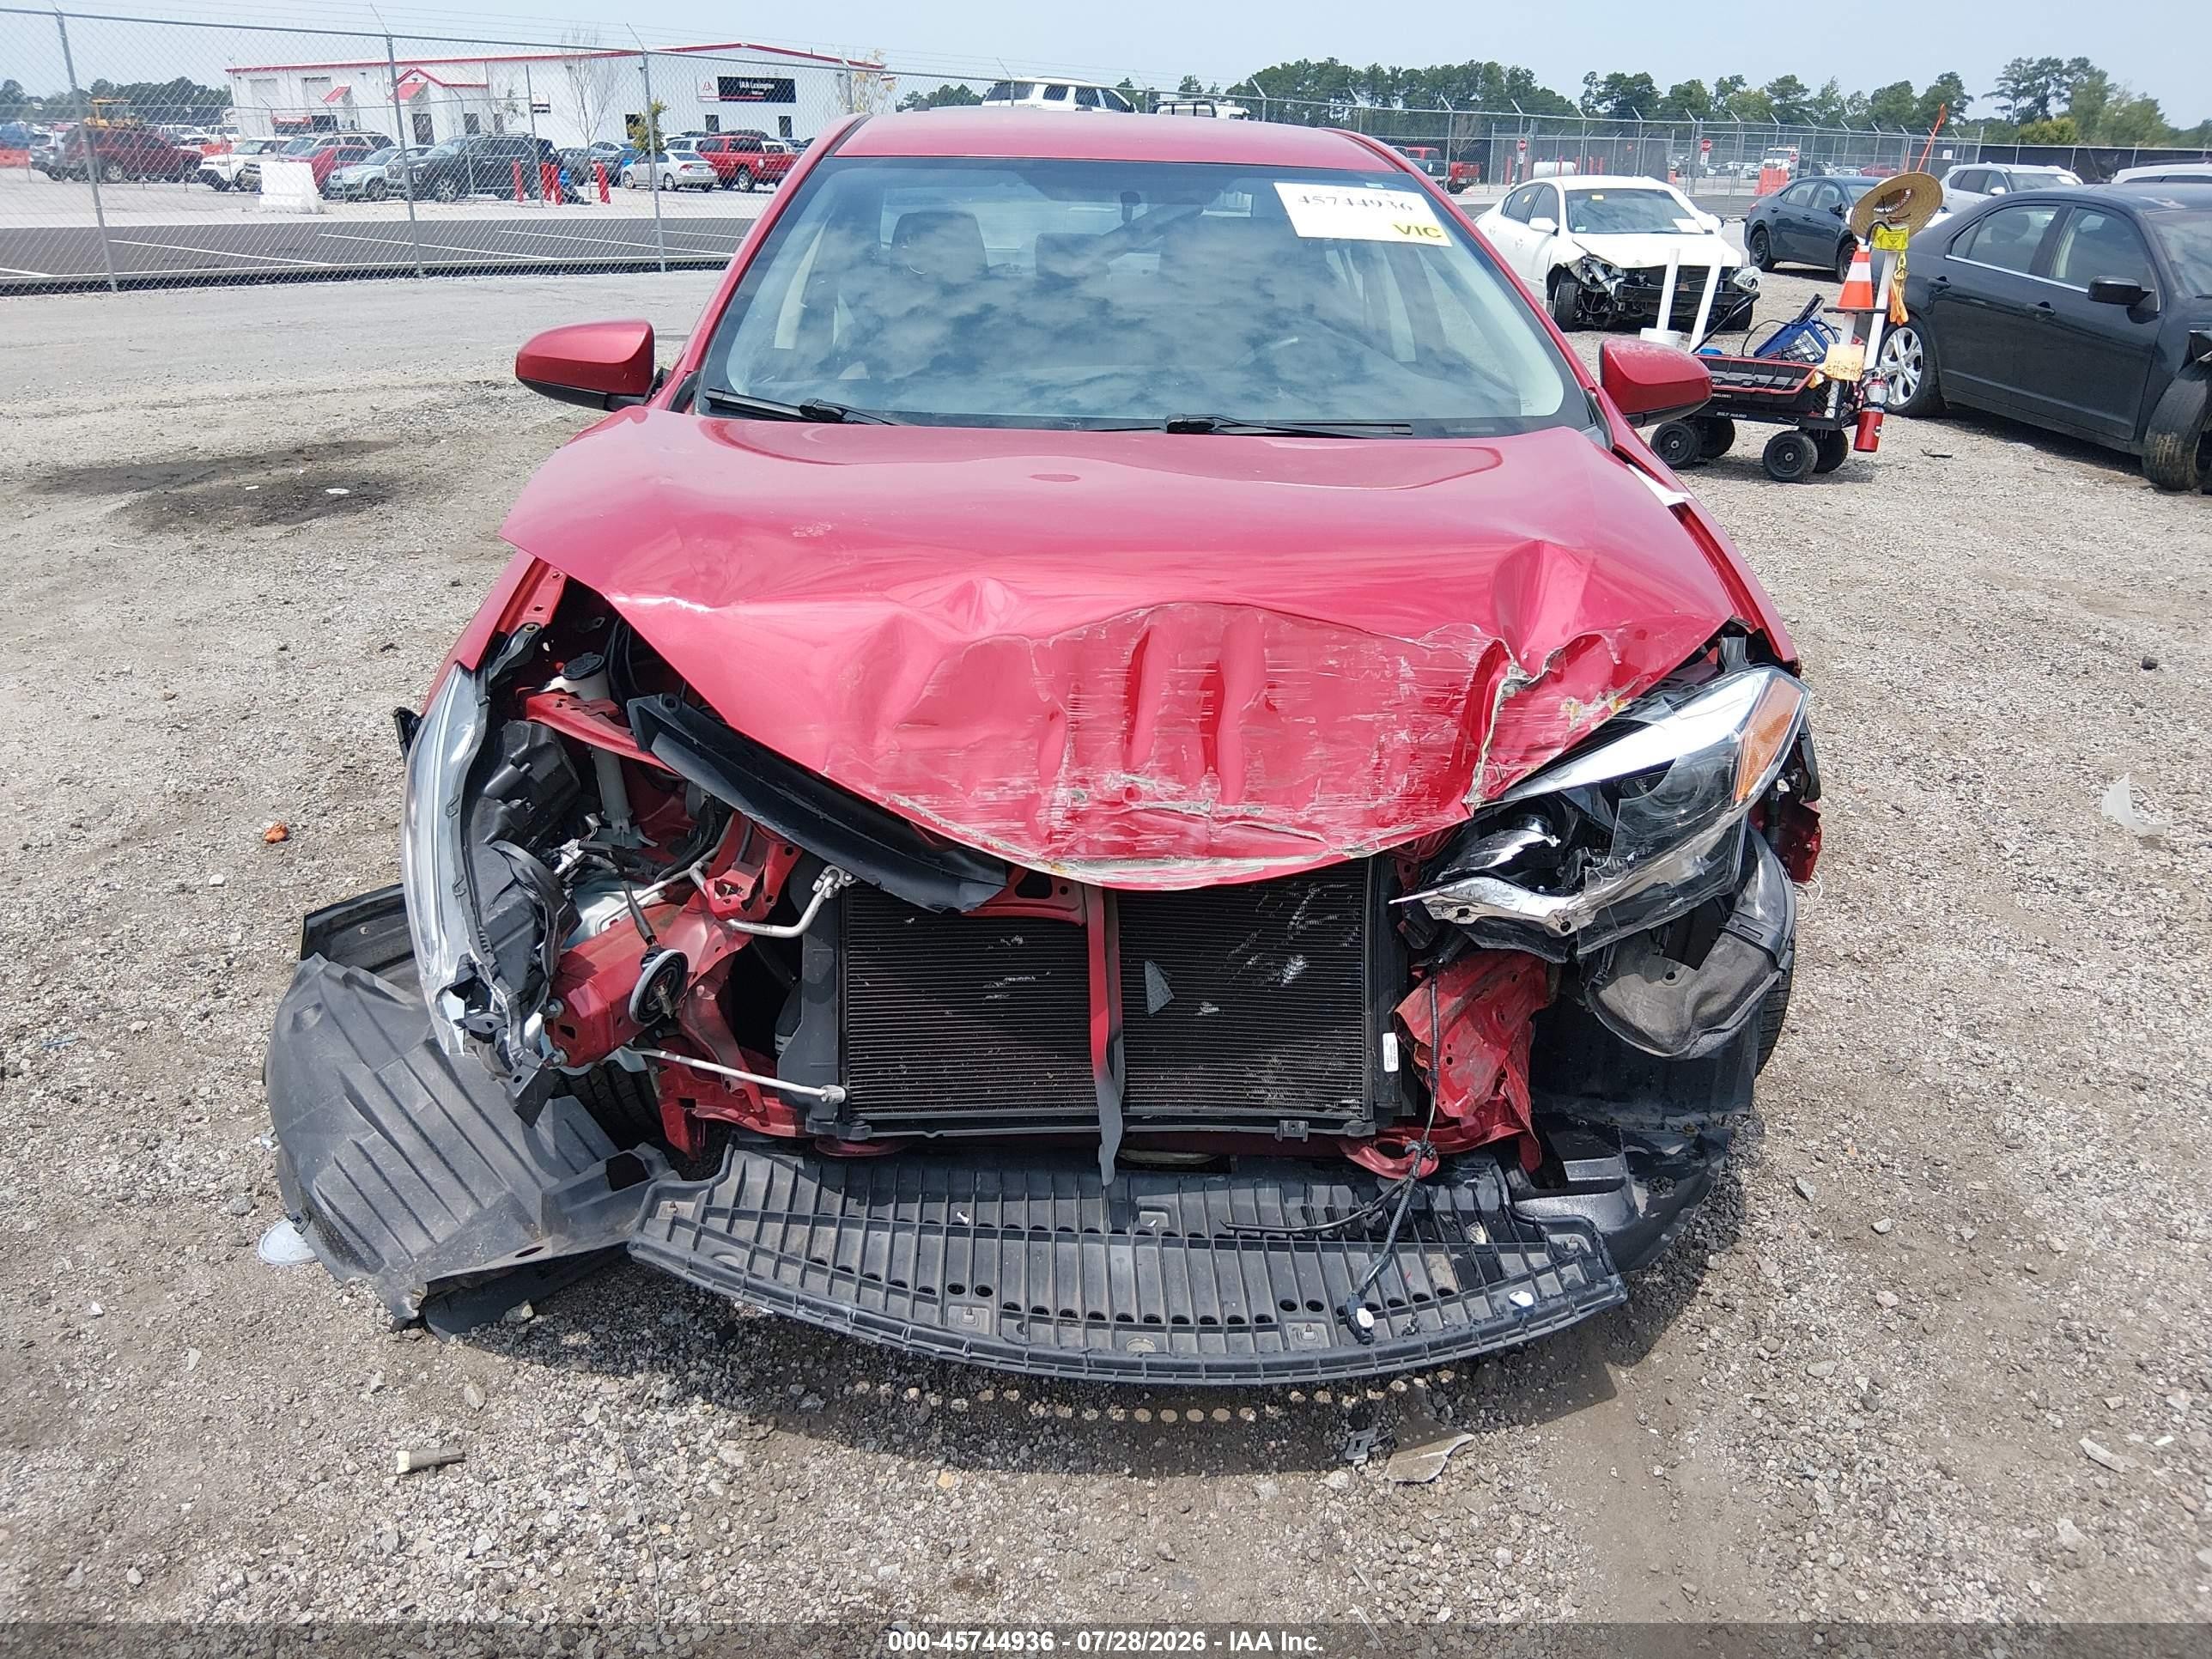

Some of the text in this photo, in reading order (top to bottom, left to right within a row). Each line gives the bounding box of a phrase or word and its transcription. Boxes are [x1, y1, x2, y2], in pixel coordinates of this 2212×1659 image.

[750, 82, 775, 90] Lexington
[1297, 195, 1413, 212] 45744936
[1393, 223, 1443, 239] VIC
